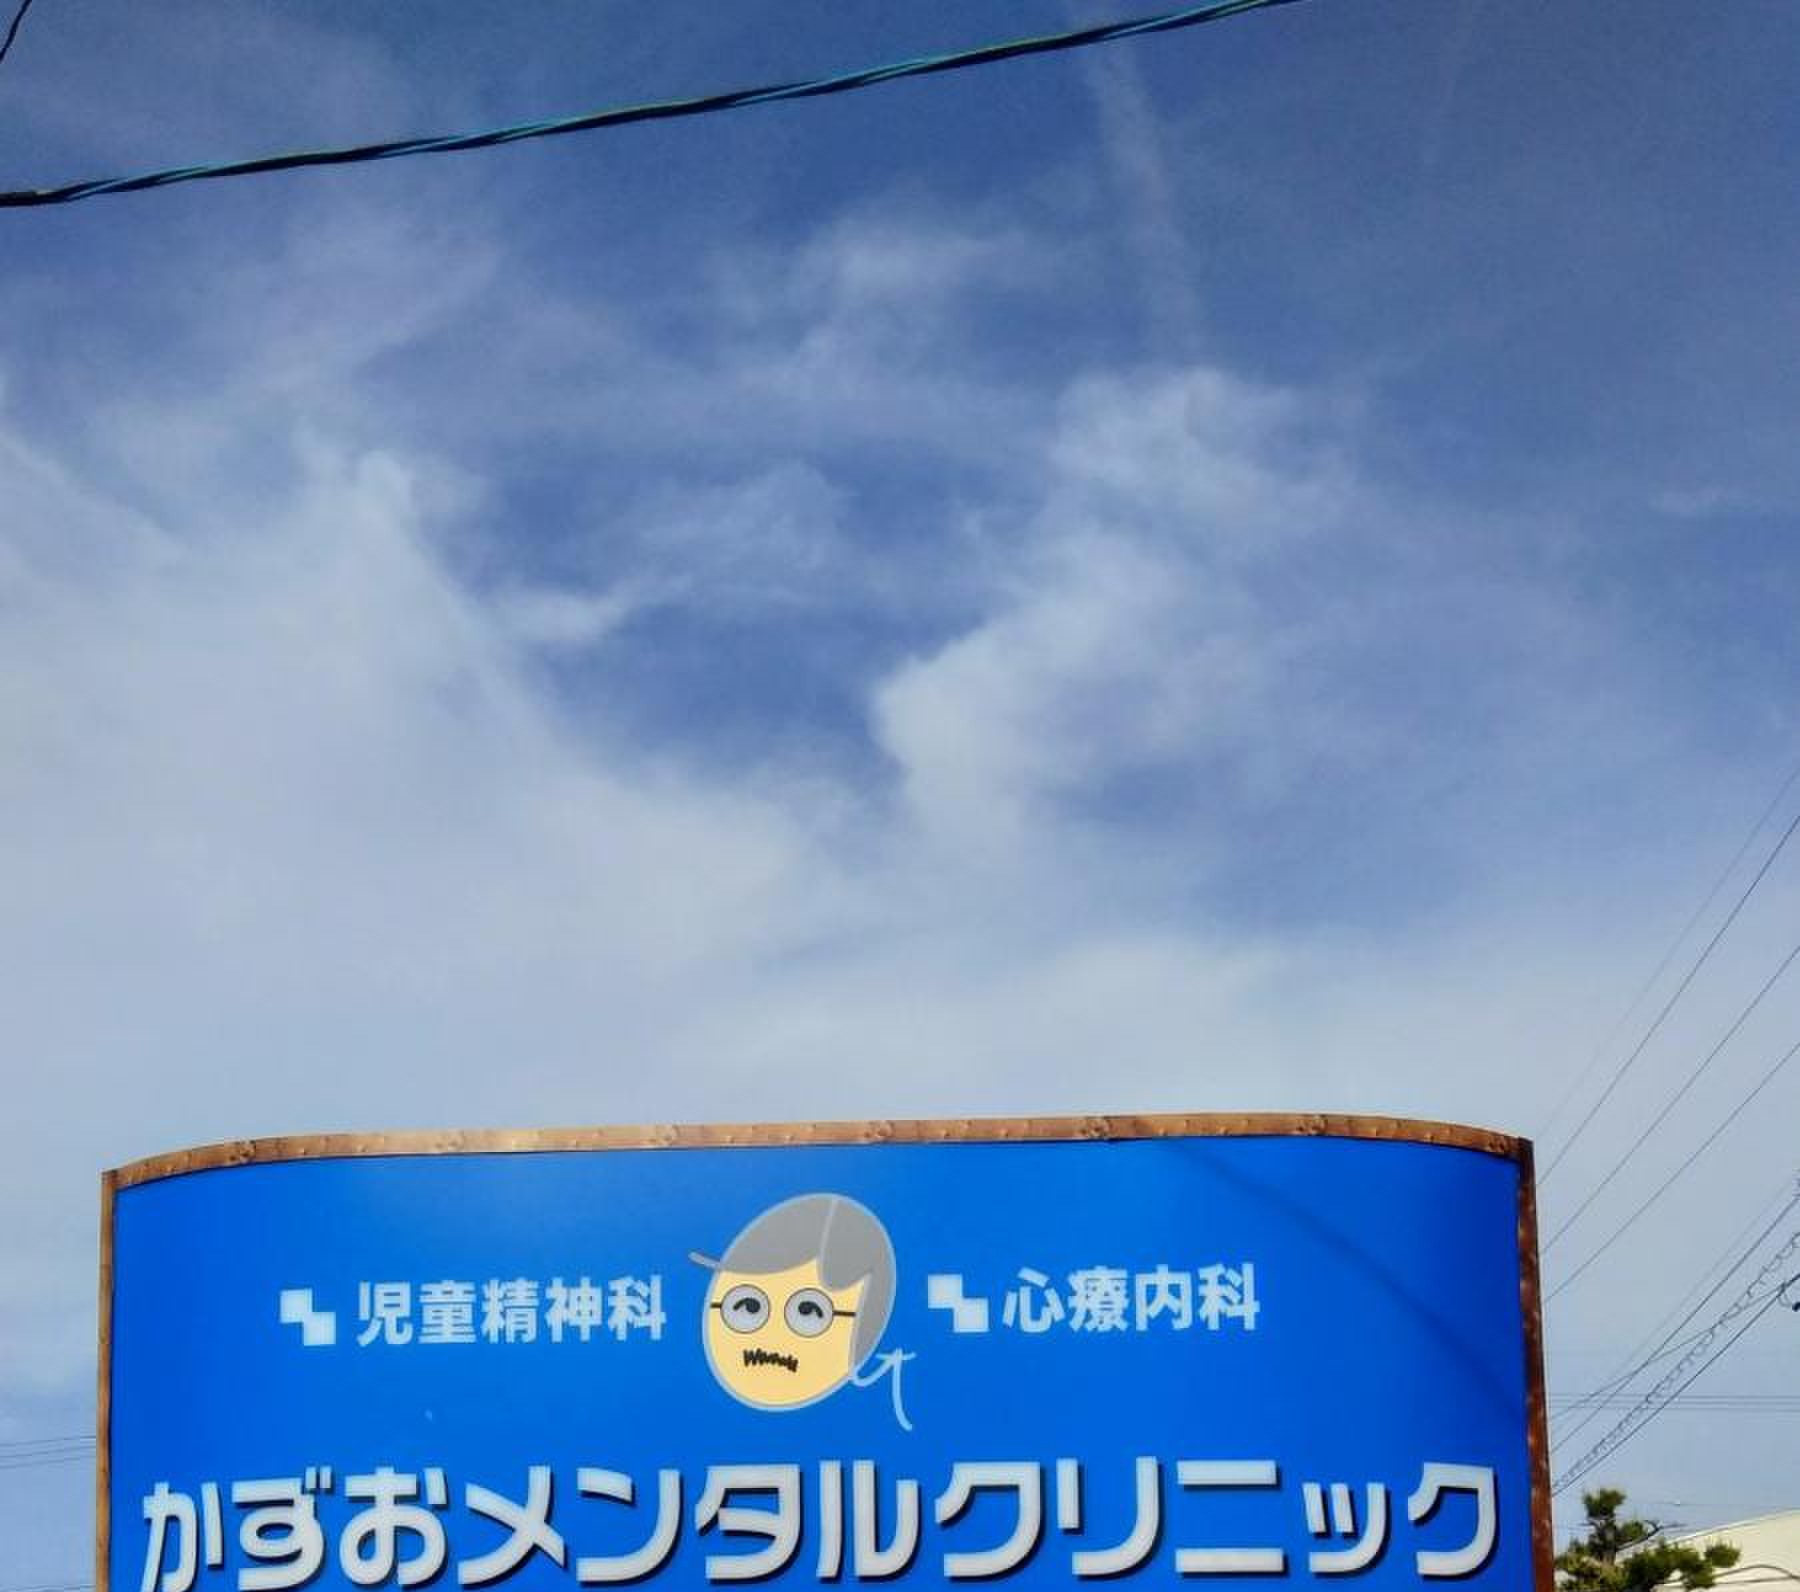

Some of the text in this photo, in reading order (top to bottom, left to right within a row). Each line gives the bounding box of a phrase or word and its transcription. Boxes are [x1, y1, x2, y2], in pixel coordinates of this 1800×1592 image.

[357, 1276, 668, 1347] 児童精神科
[1002, 1262, 1261, 1334] 心療内科
